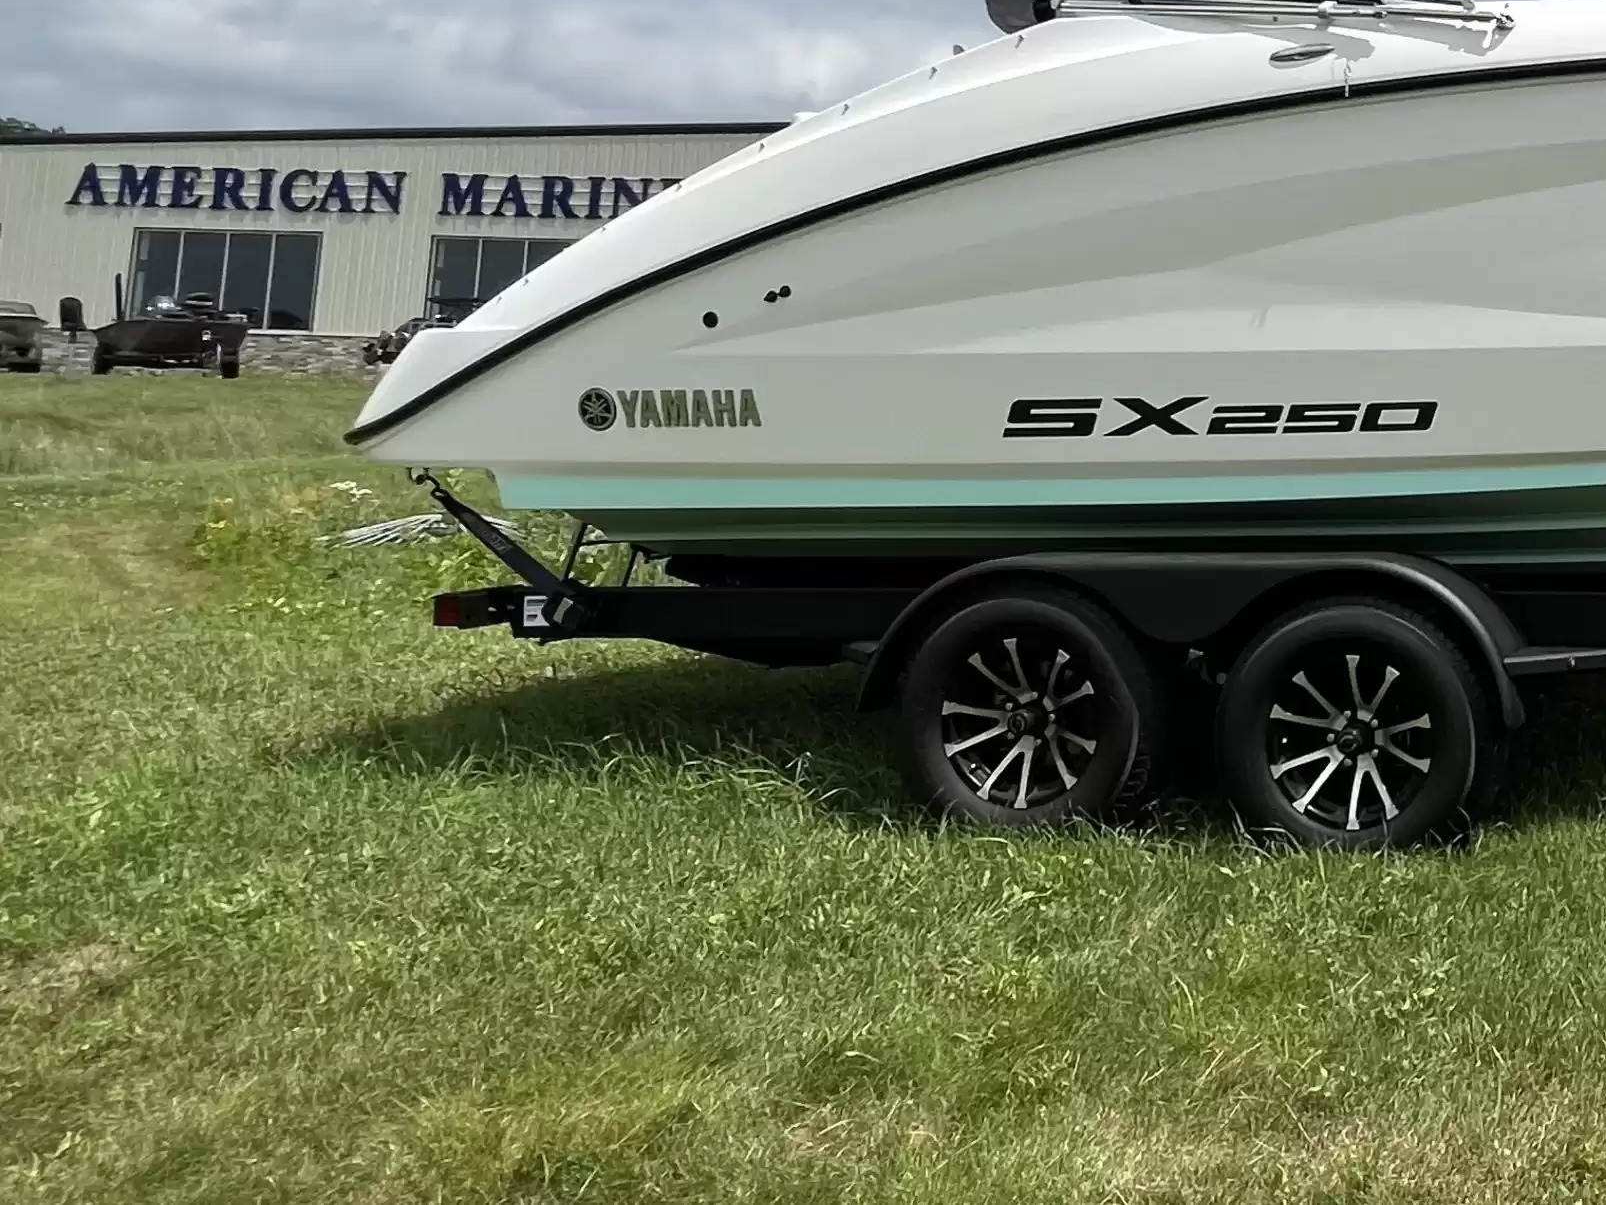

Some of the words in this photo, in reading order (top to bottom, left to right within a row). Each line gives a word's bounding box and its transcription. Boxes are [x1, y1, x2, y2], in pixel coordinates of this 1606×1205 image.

[64, 162, 408, 215] AMERICAN
[437, 172, 686, 220] MARIN
[616, 389, 762, 428] YAMAHA
[1002, 396, 1439, 438] SX250
